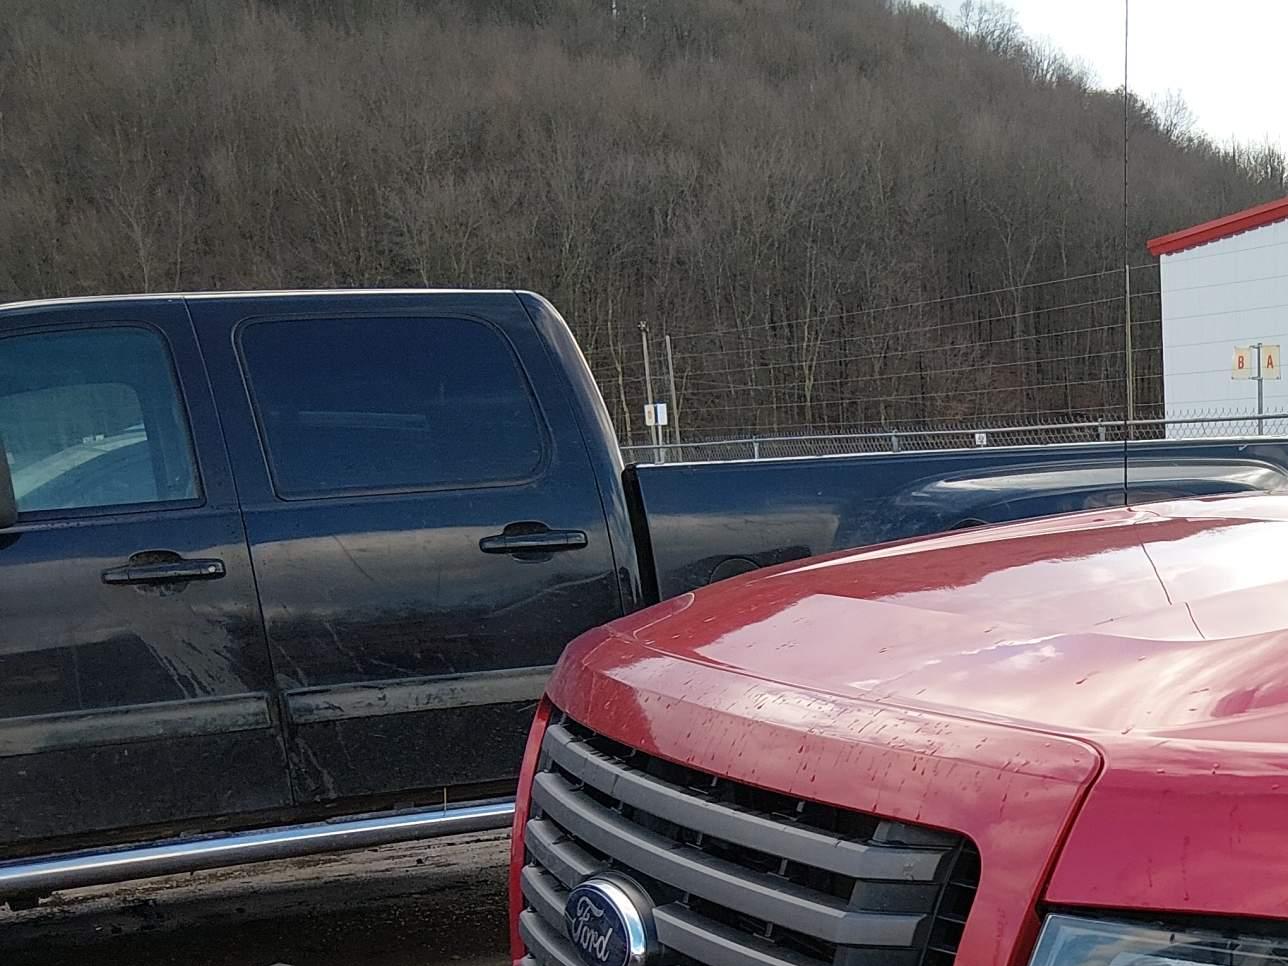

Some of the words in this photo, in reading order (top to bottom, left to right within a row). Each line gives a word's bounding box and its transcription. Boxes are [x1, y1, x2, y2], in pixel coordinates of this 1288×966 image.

[1237, 355, 1245, 370] B
[1266, 354, 1274, 369] A
[565, 895, 613, 962] Ford
